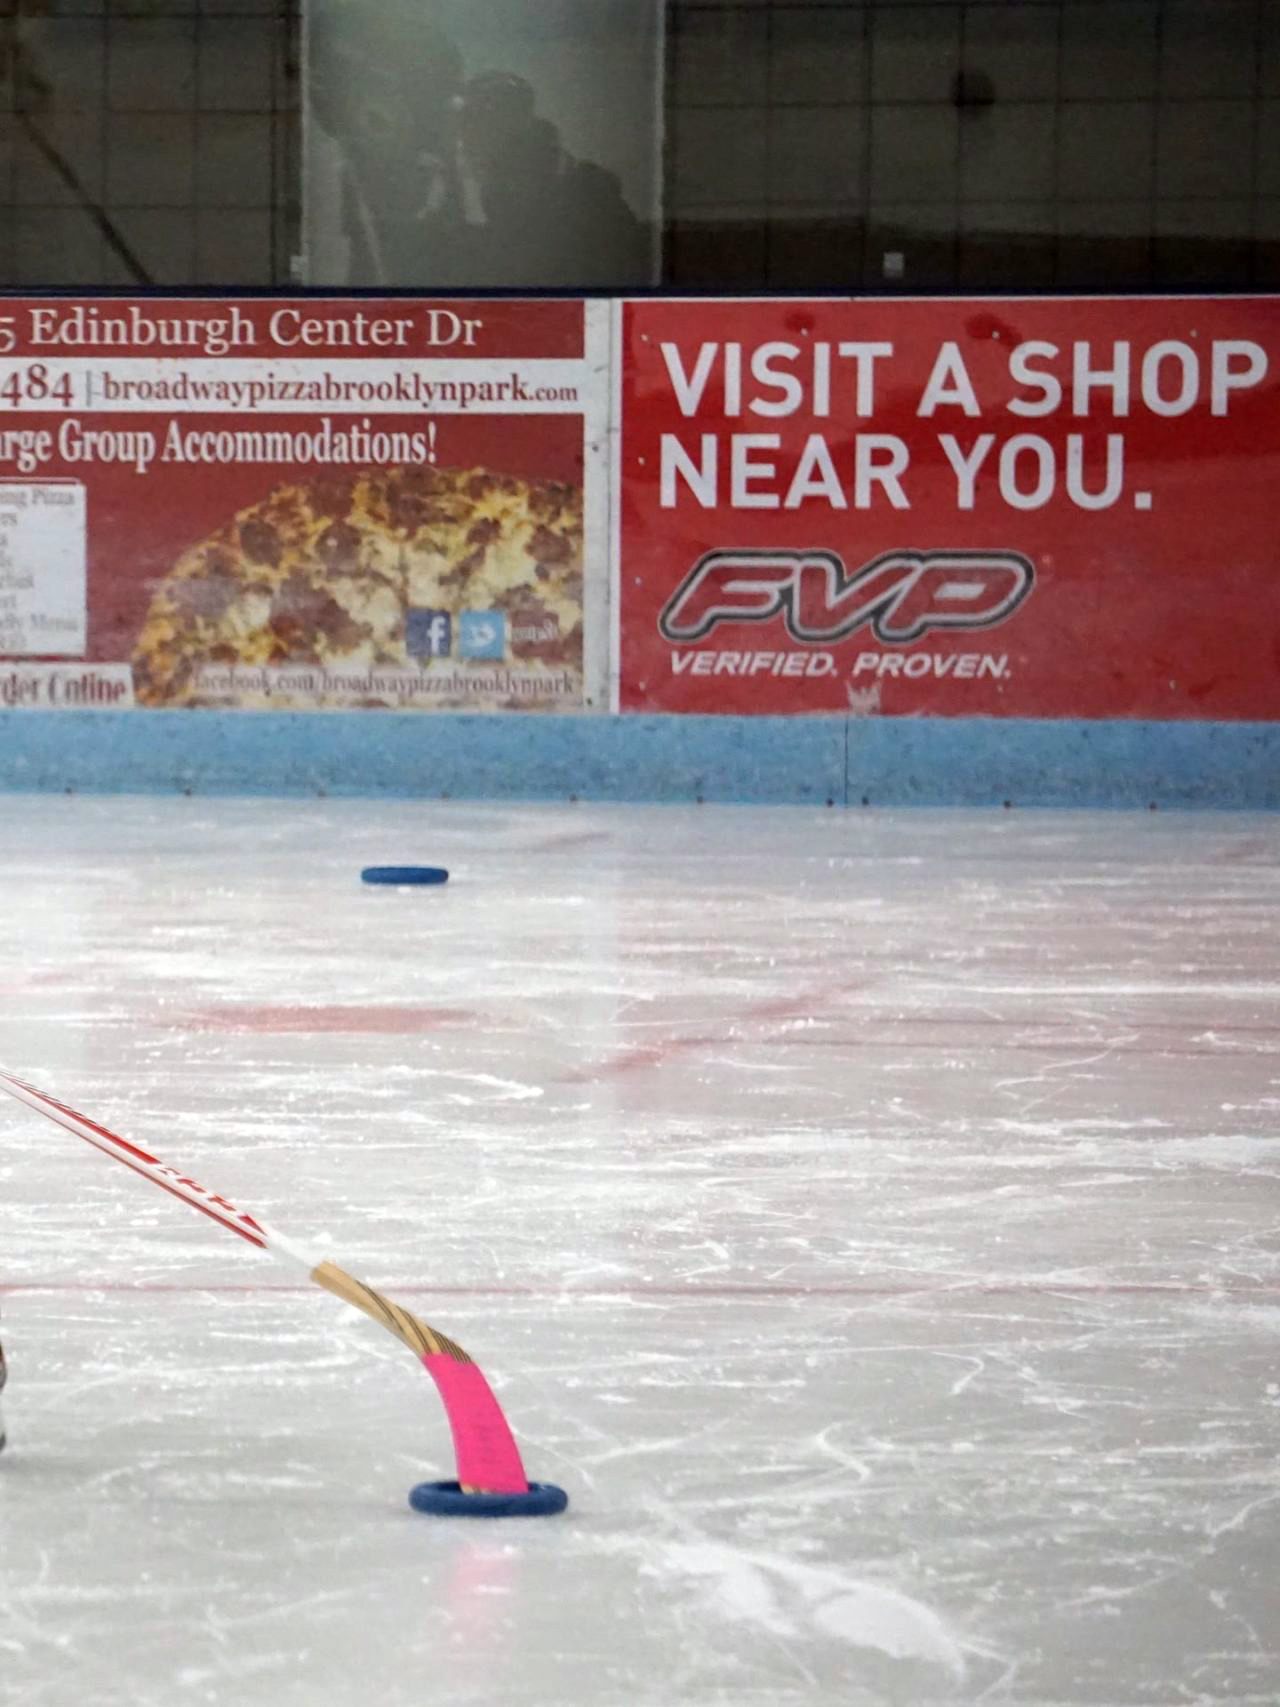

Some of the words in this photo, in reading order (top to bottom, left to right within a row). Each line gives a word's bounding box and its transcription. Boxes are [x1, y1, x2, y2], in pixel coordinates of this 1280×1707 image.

[27, 305, 255, 356] Edinburgh
[270, 308, 415, 347] Center
[426, 308, 484, 347] Dr
[101, 371, 578, 408] broadwaypizzabrooklynpark.com
[660, 341, 894, 417] VISIT
[916, 341, 982, 417] A
[1007, 340, 1269, 418] SHOP
[58, 418, 157, 474] Group
[161, 418, 437, 465] Accommodations!
[660, 434, 911, 509] NEAR
[938, 433, 1153, 510] YOU.
[660, 548, 1036, 644] FVP
[670, 650, 838, 678] VERIFIED.
[851, 652, 1012, 680] PROVEN.
